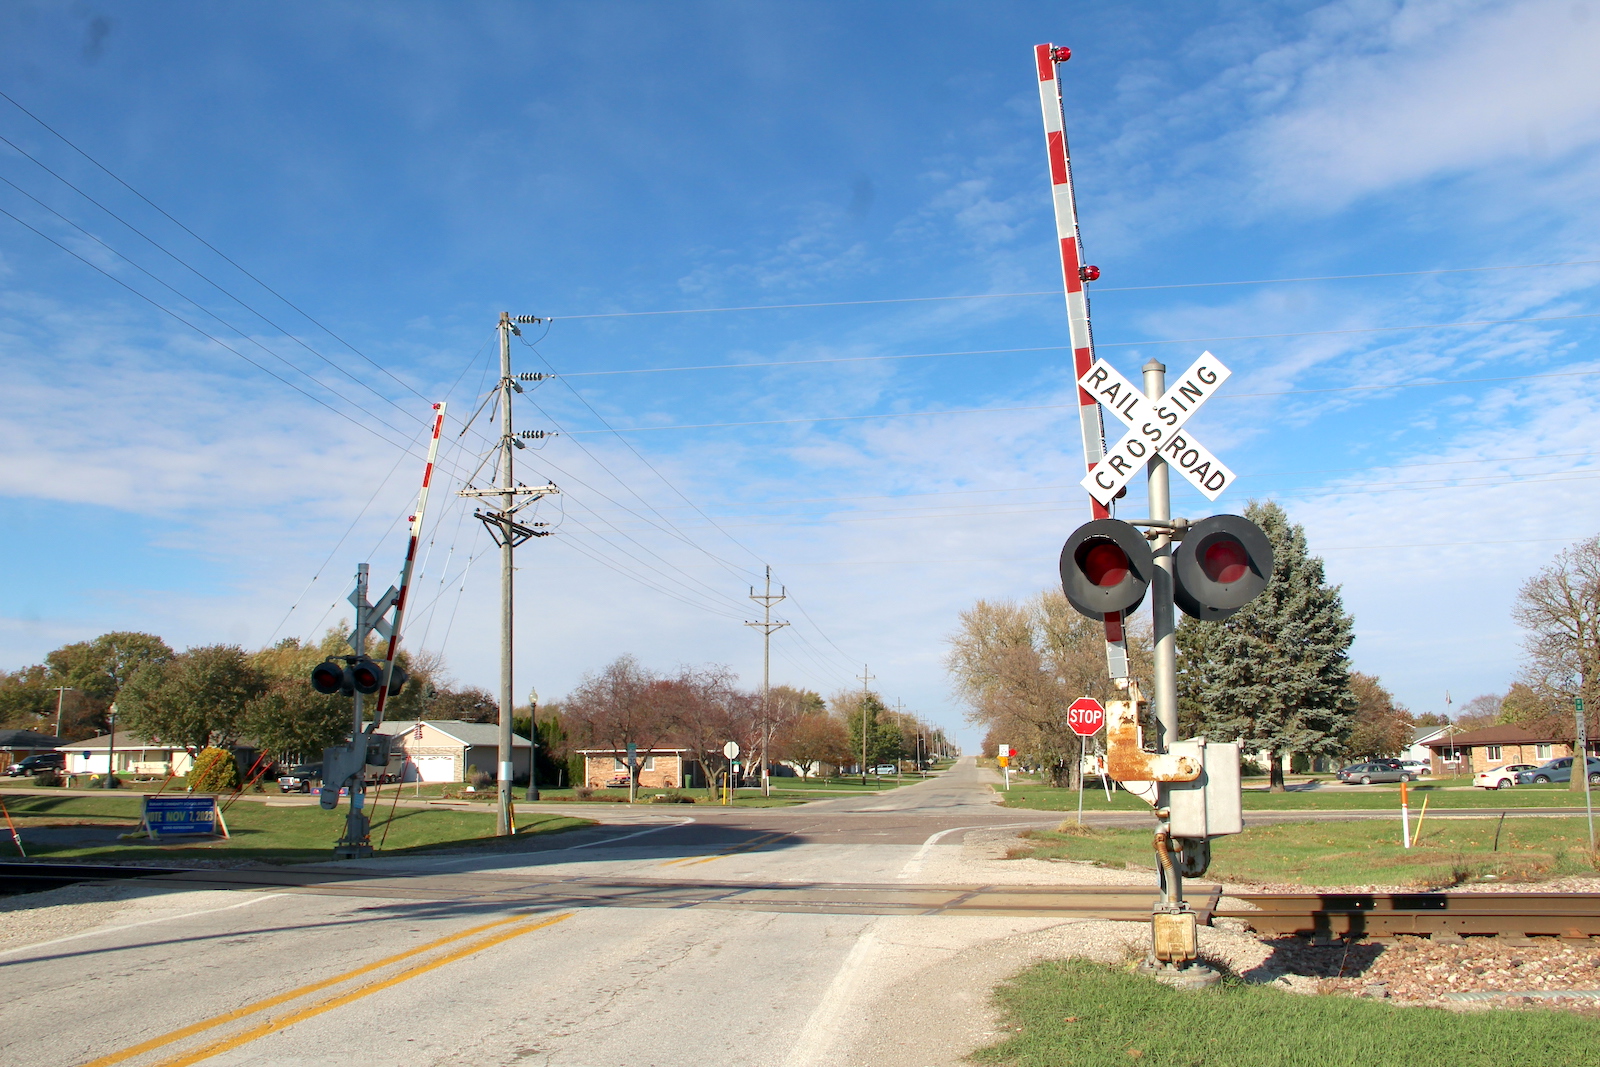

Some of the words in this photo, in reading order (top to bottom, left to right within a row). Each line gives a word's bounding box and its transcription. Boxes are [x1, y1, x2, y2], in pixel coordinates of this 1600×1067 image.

[1086, 366, 1139, 421] RAIL
[1164, 435, 1225, 492] ROAD
[1095, 366, 1217, 490] CROSSING
[1069, 708, 1102, 724] STOP
[166, 811, 186, 821] NOV
[196, 811, 213, 821] 2023
